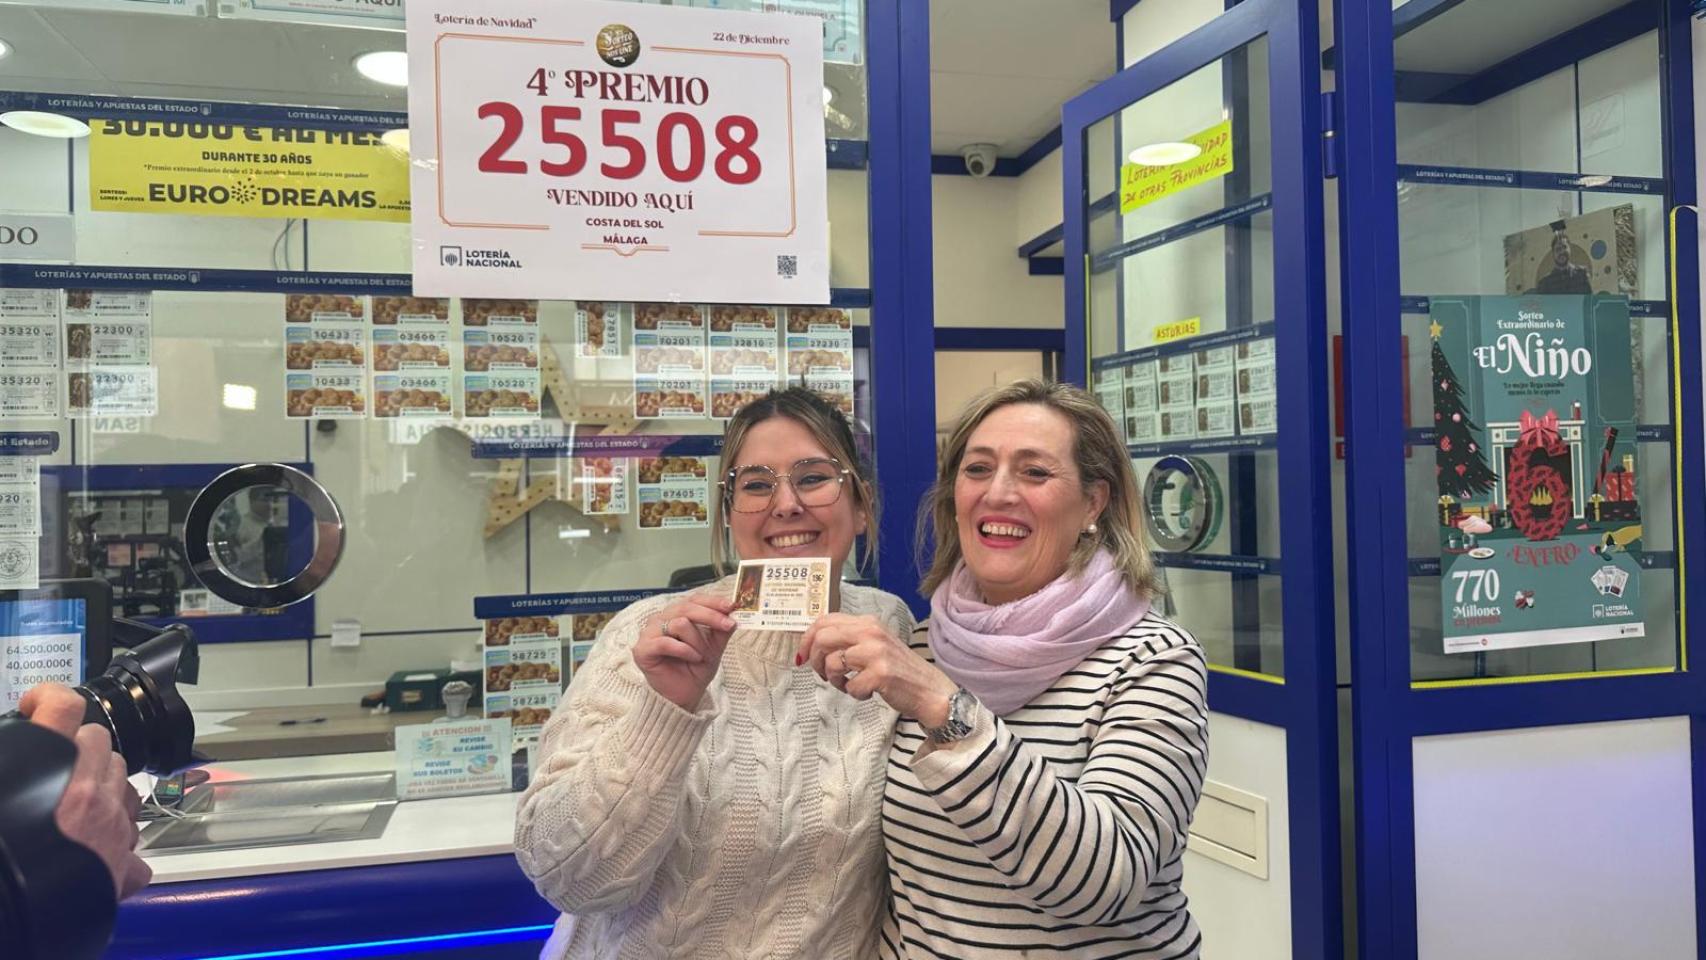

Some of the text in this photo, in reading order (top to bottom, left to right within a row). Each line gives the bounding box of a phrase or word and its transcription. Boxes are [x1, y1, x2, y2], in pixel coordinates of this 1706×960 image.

[476, 16, 489, 26] de
[491, 17, 537, 29] Navidad
[712, 32, 790, 45] 22 de Diciembre
[564, 69, 709, 106] PREMIO
[47, 98, 199, 113] LOTERÍAS Y APUESTAS DEL ESTADO
[288, 111, 331, 120] LOTERÍAS
[338, 114, 378, 123] APUESTAS
[477, 101, 762, 185] 25508
[202, 151, 312, 165] DURANTE 30 AÑOS
[1139, 180, 1167, 200] OTRAS
[1170, 154, 1228, 188] PROVINCIAS
[149, 182, 377, 208] EURO DREAMS
[547, 188, 694, 213] VENDIDO AQUÍ
[585, 217, 664, 229] COSTA DEL SOL
[603, 233, 648, 245] MÁLAGA
[465, 249, 511, 259] LOTERÍA
[466, 258, 522, 268] NACIONAL
[34, 270, 82, 279] LOTERÍAS
[89, 272, 134, 280] APUESTAS
[153, 273, 187, 281] ESTADO
[277, 276, 320, 284] LOTERÍAS
[328, 277, 368, 286] APUESTAS
[369, 278, 384, 286] DEL
[386, 278, 412, 286] ESTAD
[1518, 310, 1544, 321] Sorteo
[1497, 319, 1566, 329] Extraordinario de
[1156, 322, 1196, 339] ASTURIAS
[1472, 332, 1592, 380] El Niño
[10, 437, 49, 446] Estado
[594, 440, 609, 448] DEL
[609, 439, 639, 447] ESTADO
[766, 567, 808, 578] 25508
[1452, 568, 1500, 603] 770
[511, 598, 552, 608] LOTERÍAS
[559, 597, 597, 606] APUESTAS
[613, 594, 640, 602] ESTADO
[1453, 604, 1501, 619] Millones
[1605, 609, 1634, 617] NACIONAL
[6, 643, 73, 655] 64.500.000€
[6, 659, 73, 670] 40.000.000€
[13, 673, 73, 685] 3.600.000€
